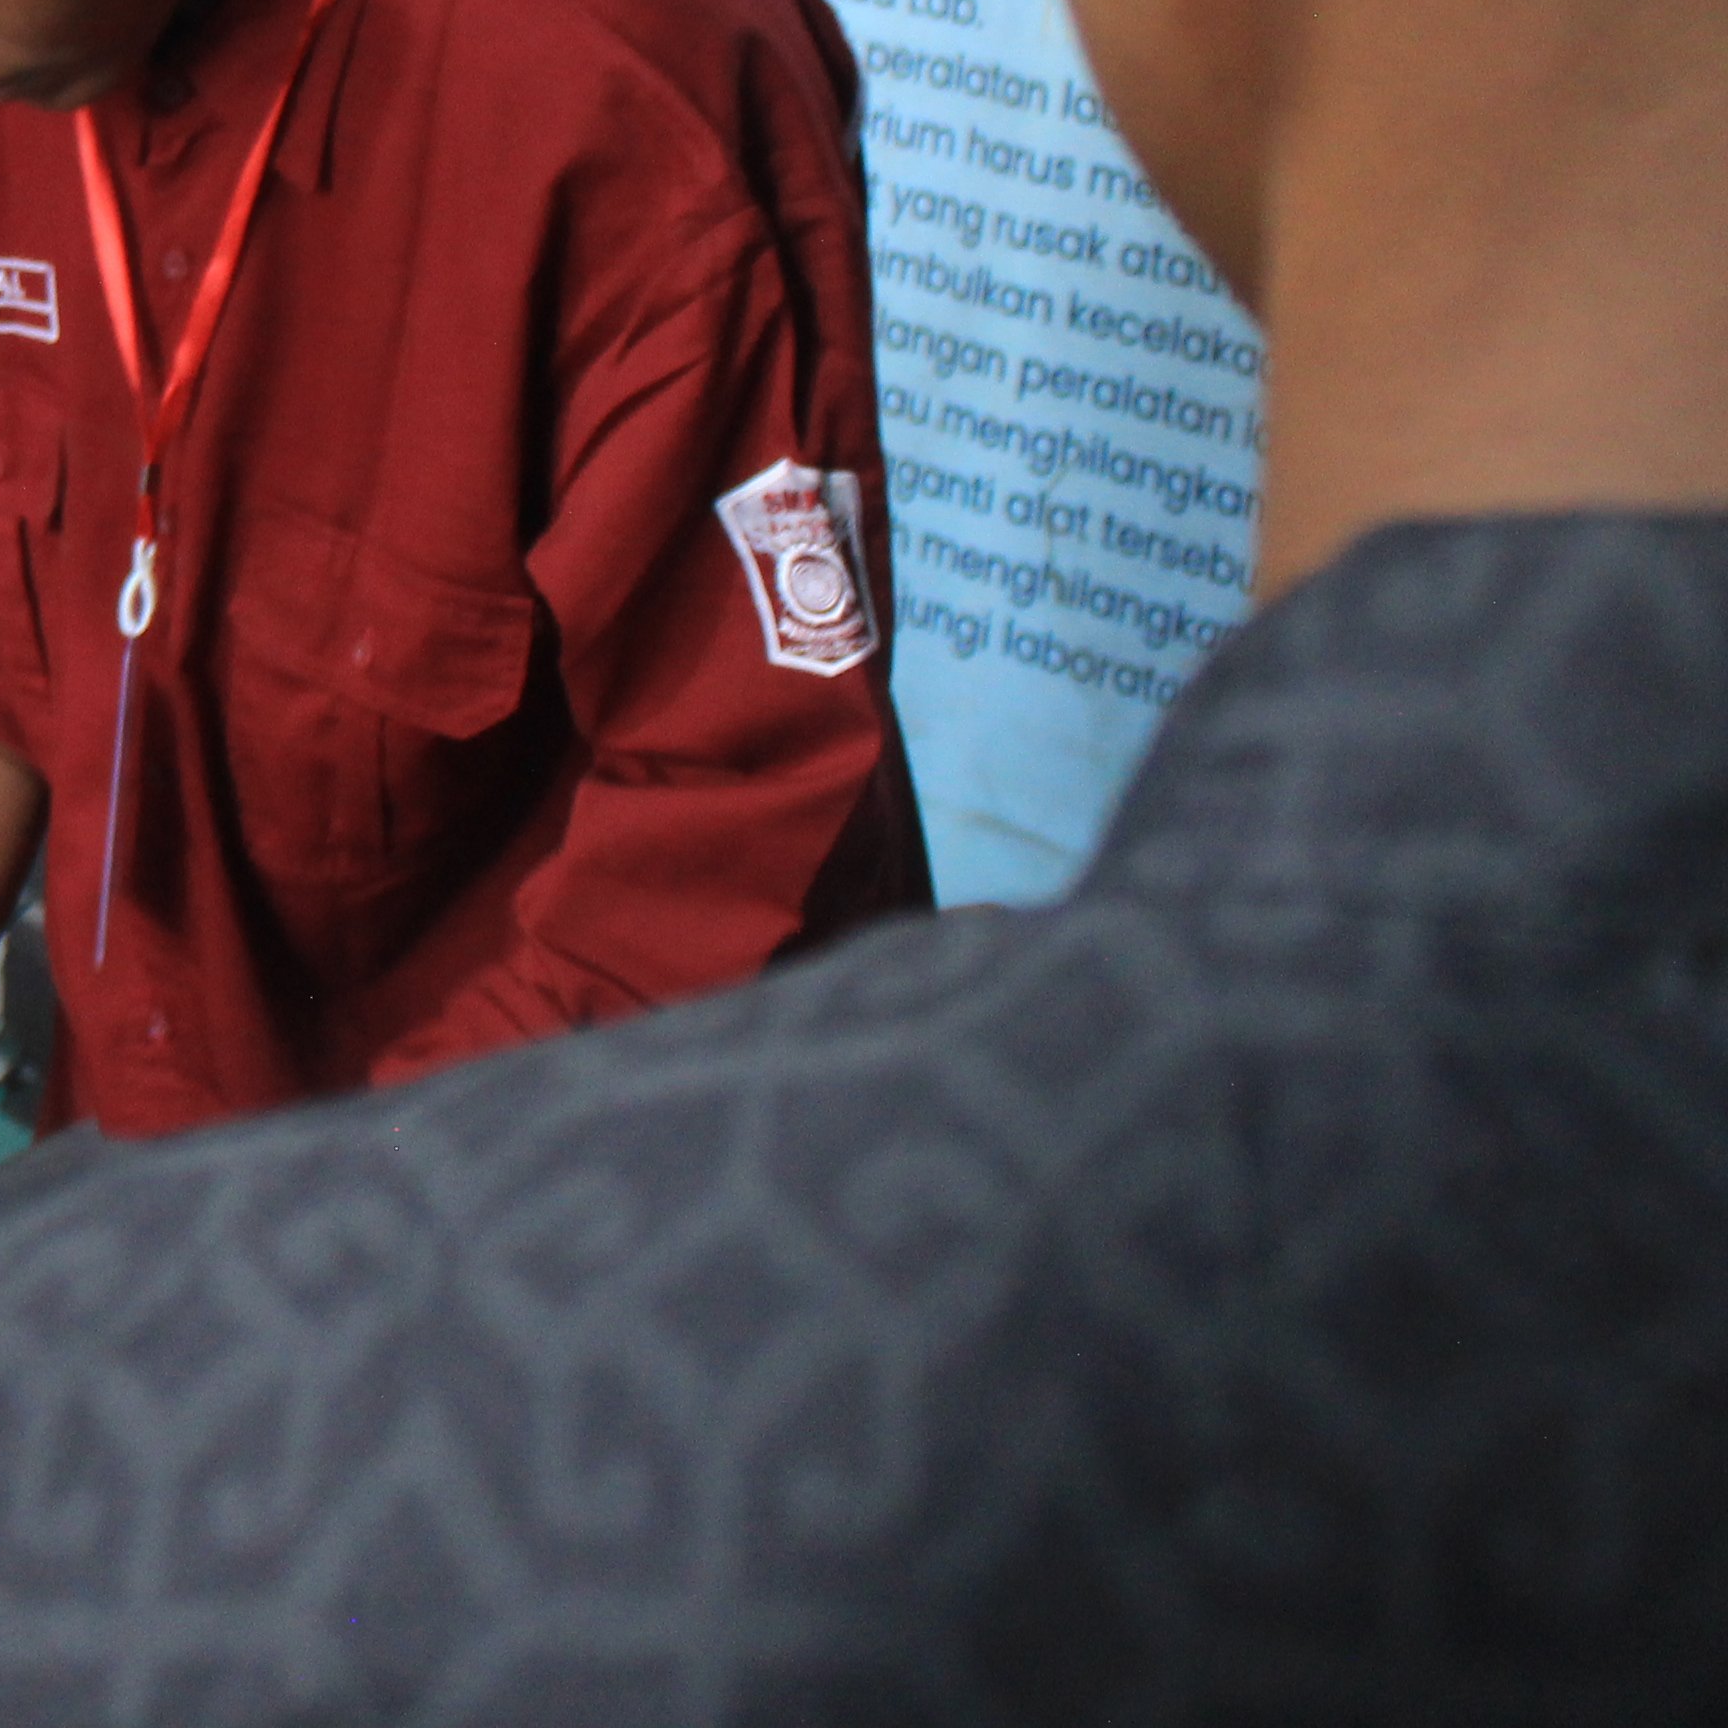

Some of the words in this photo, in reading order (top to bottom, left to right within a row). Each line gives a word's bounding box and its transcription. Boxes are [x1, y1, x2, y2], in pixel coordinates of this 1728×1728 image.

[863, 38, 1050, 116] peralatan
[867, 109, 955, 159] rium
[967, 128, 1077, 191] harus
[889, 182, 985, 248] yang
[994, 211, 1110, 264] rusak
[1119, 241, 1228, 297] atau
[875, 244, 1053, 325] imbulkan
[877, 307, 1007, 382] langan
[1017, 358, 1234, 444] peralatan
[881, 385, 931, 425] au
[1005, 490, 1089, 543] alat
